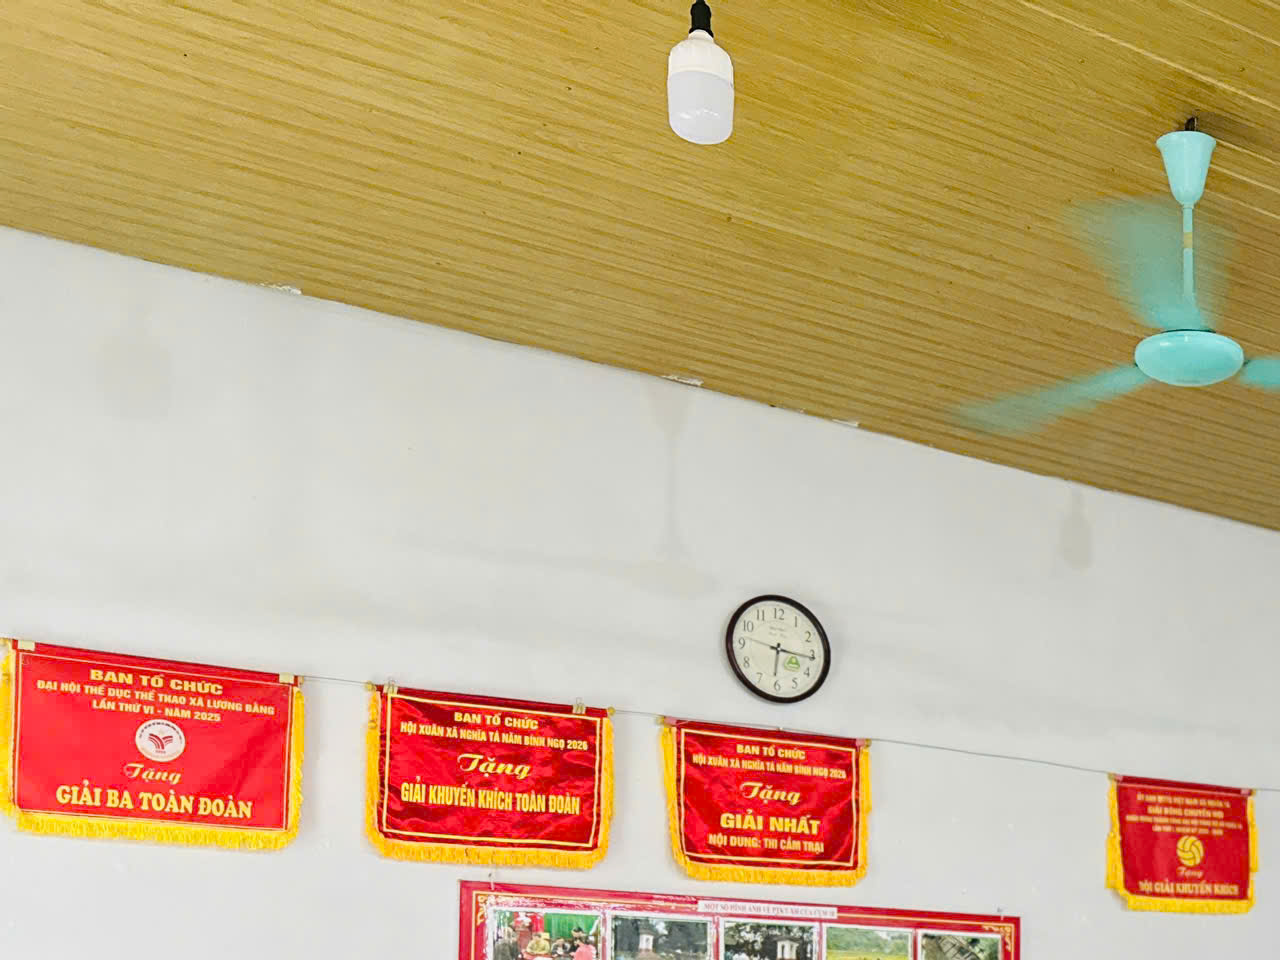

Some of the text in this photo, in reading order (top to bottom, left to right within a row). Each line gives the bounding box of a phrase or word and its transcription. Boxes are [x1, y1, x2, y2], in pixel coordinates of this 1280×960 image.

[756, 609, 765, 621] 11
[774, 607, 785, 621] 12
[794, 615, 798, 628] 1
[743, 620, 754, 632] 10
[738, 637, 746, 649] 9
[804, 630, 812, 643] 2
[743, 656, 750, 668] 8
[756, 671, 763, 683] 7
[803, 667, 810, 678] 4
[90, 669, 223, 695] BAN TỔ CHỨC
[773, 680, 781, 691] 6
[791, 677, 798, 689] 5
[37, 679, 58, 692] ĐẠI
[60, 682, 80, 694] HỘI
[84, 684, 105, 696] THỂ
[108, 687, 131, 699] DỤC
[158, 693, 186, 705] THAO
[207, 699, 243, 712] LƯƠNG
[119, 701, 142, 713] THỨ
[143, 705, 154, 714] VI
[165, 707, 191, 719] NĂM
[194, 711, 221, 722] 2025
[454, 712, 539, 730] BAN TỔ CHỨC
[400, 721, 417, 736] HỘI
[419, 723, 444, 737] XUÂN
[460, 728, 487, 741] NGHĨA
[501, 731, 522, 745] NĂM
[547, 737, 565, 751] NGỌ
[567, 740, 588, 751] 2026
[736, 744, 806, 760] BAN TỔ CHỨC
[124, 763, 182, 785] Tặng
[457, 753, 531, 779] Tặng
[56, 779, 253, 819] GIẢI BA TOÀN ĐOÀN
[400, 776, 580, 815] GIẢI KHUYẾN KHÍCH TOÀN ĐOÀN
[740, 782, 801, 806] Tặng
[720, 808, 820, 835] GIẢI NHẤT
[708, 833, 728, 847] NỘI
[730, 835, 761, 848] DUNG:
[764, 838, 778, 849] THI
[803, 840, 824, 855] TRẠI
